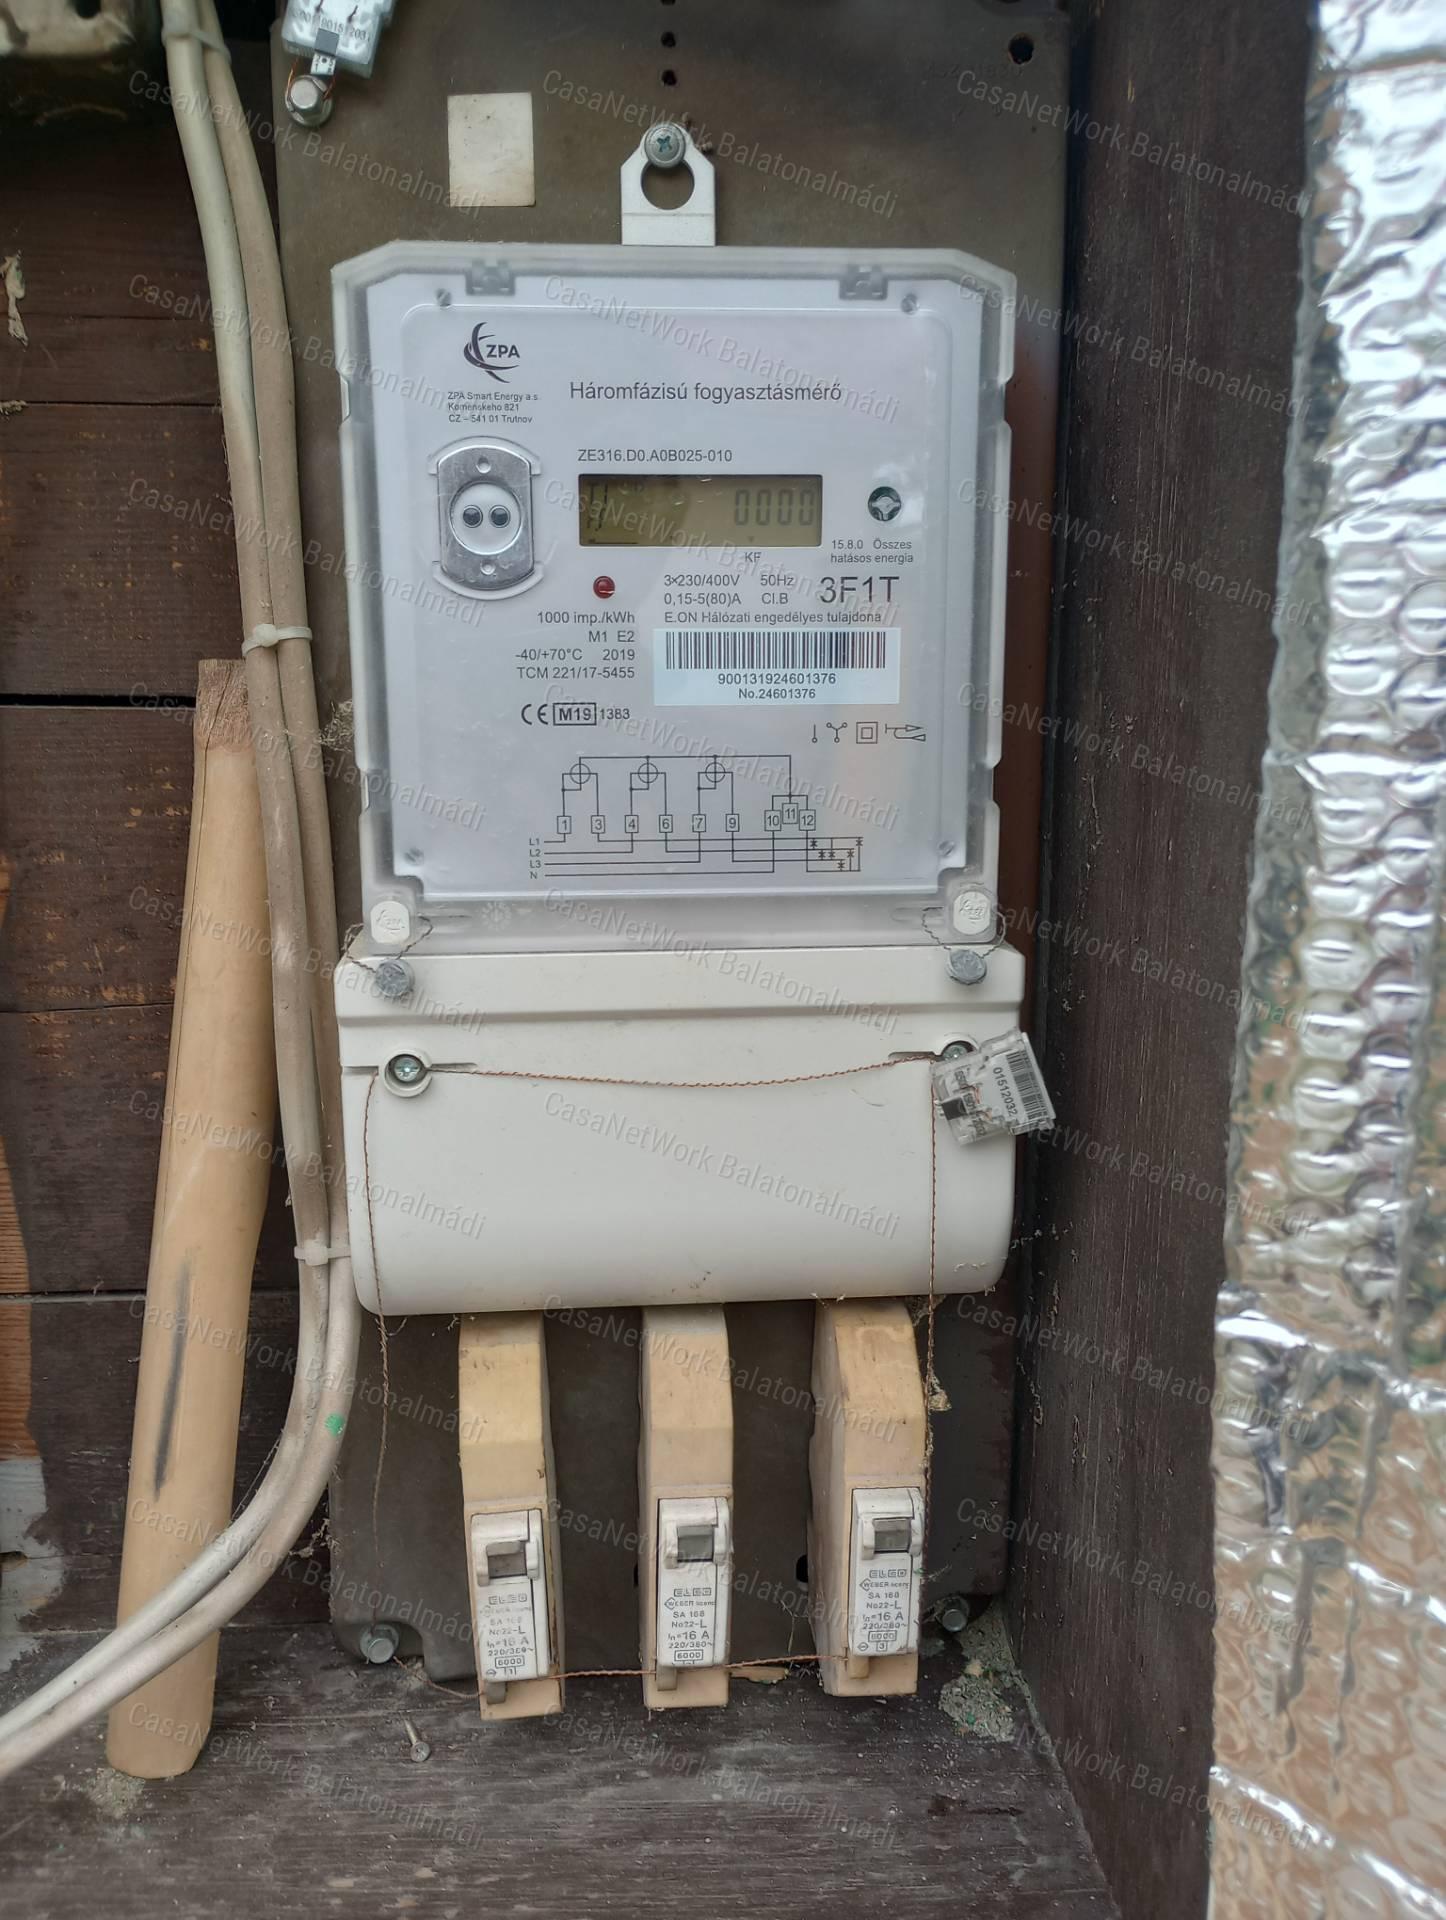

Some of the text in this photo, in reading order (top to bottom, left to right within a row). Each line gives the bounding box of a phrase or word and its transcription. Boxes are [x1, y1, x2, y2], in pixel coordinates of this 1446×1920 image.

[486, 345, 520, 358] ZPA
[448, 392, 465, 400] ZPA
[467, 392, 492, 400] Smart
[494, 392, 523, 402] Energy
[570, 382, 842, 404] Háromfázisú fogyasztásmérő
[504, 403, 519, 411] 821
[449, 414, 461, 422] CZ
[471, 414, 486, 422] 541
[489, 414, 499, 422] 01
[501, 414, 533, 423] Trutnov
[578, 449, 733, 463] ZE316.D0.A0B025-010
[734, 489, 815, 527] 0000
[832, 537, 912, 549] 15.8.0 Összes
[745, 552, 761, 563] KF
[830, 553, 914, 565] hatásos energia
[760, 575, 795, 587] 50Hz
[820, 576, 900, 604] 3F1T
[664, 592, 741, 606] 0,15-5(80)A
[537, 611, 635, 626] 1000 imp./kWh
[664, 611, 882, 625] E.ON Hálózati engedélyes tulajdona
[588, 630, 635, 642] M1 E2
[602, 648, 635, 661] 2019
[516, 667, 635, 679] TCM 221/17-5455
[718, 673, 836, 685] 900131924601376
[738, 688, 816, 699] No.24601376
[558, 708, 592, 720] M19
[600, 708, 630, 720] 1383
[785, 808, 796, 819] 11
[767, 815, 780, 826] 10
[802, 815, 814, 826] 12
[529, 838, 540, 846] L1
[529, 849, 541, 858] L2
[530, 860, 541, 869] L3
[993, 1067, 1018, 1116] 01512032
[895, 1611, 904, 1620] A
[520, 1636, 529, 1645] A
[701, 1630, 709, 1639] A
[498, 1658, 522, 1666] 6000
